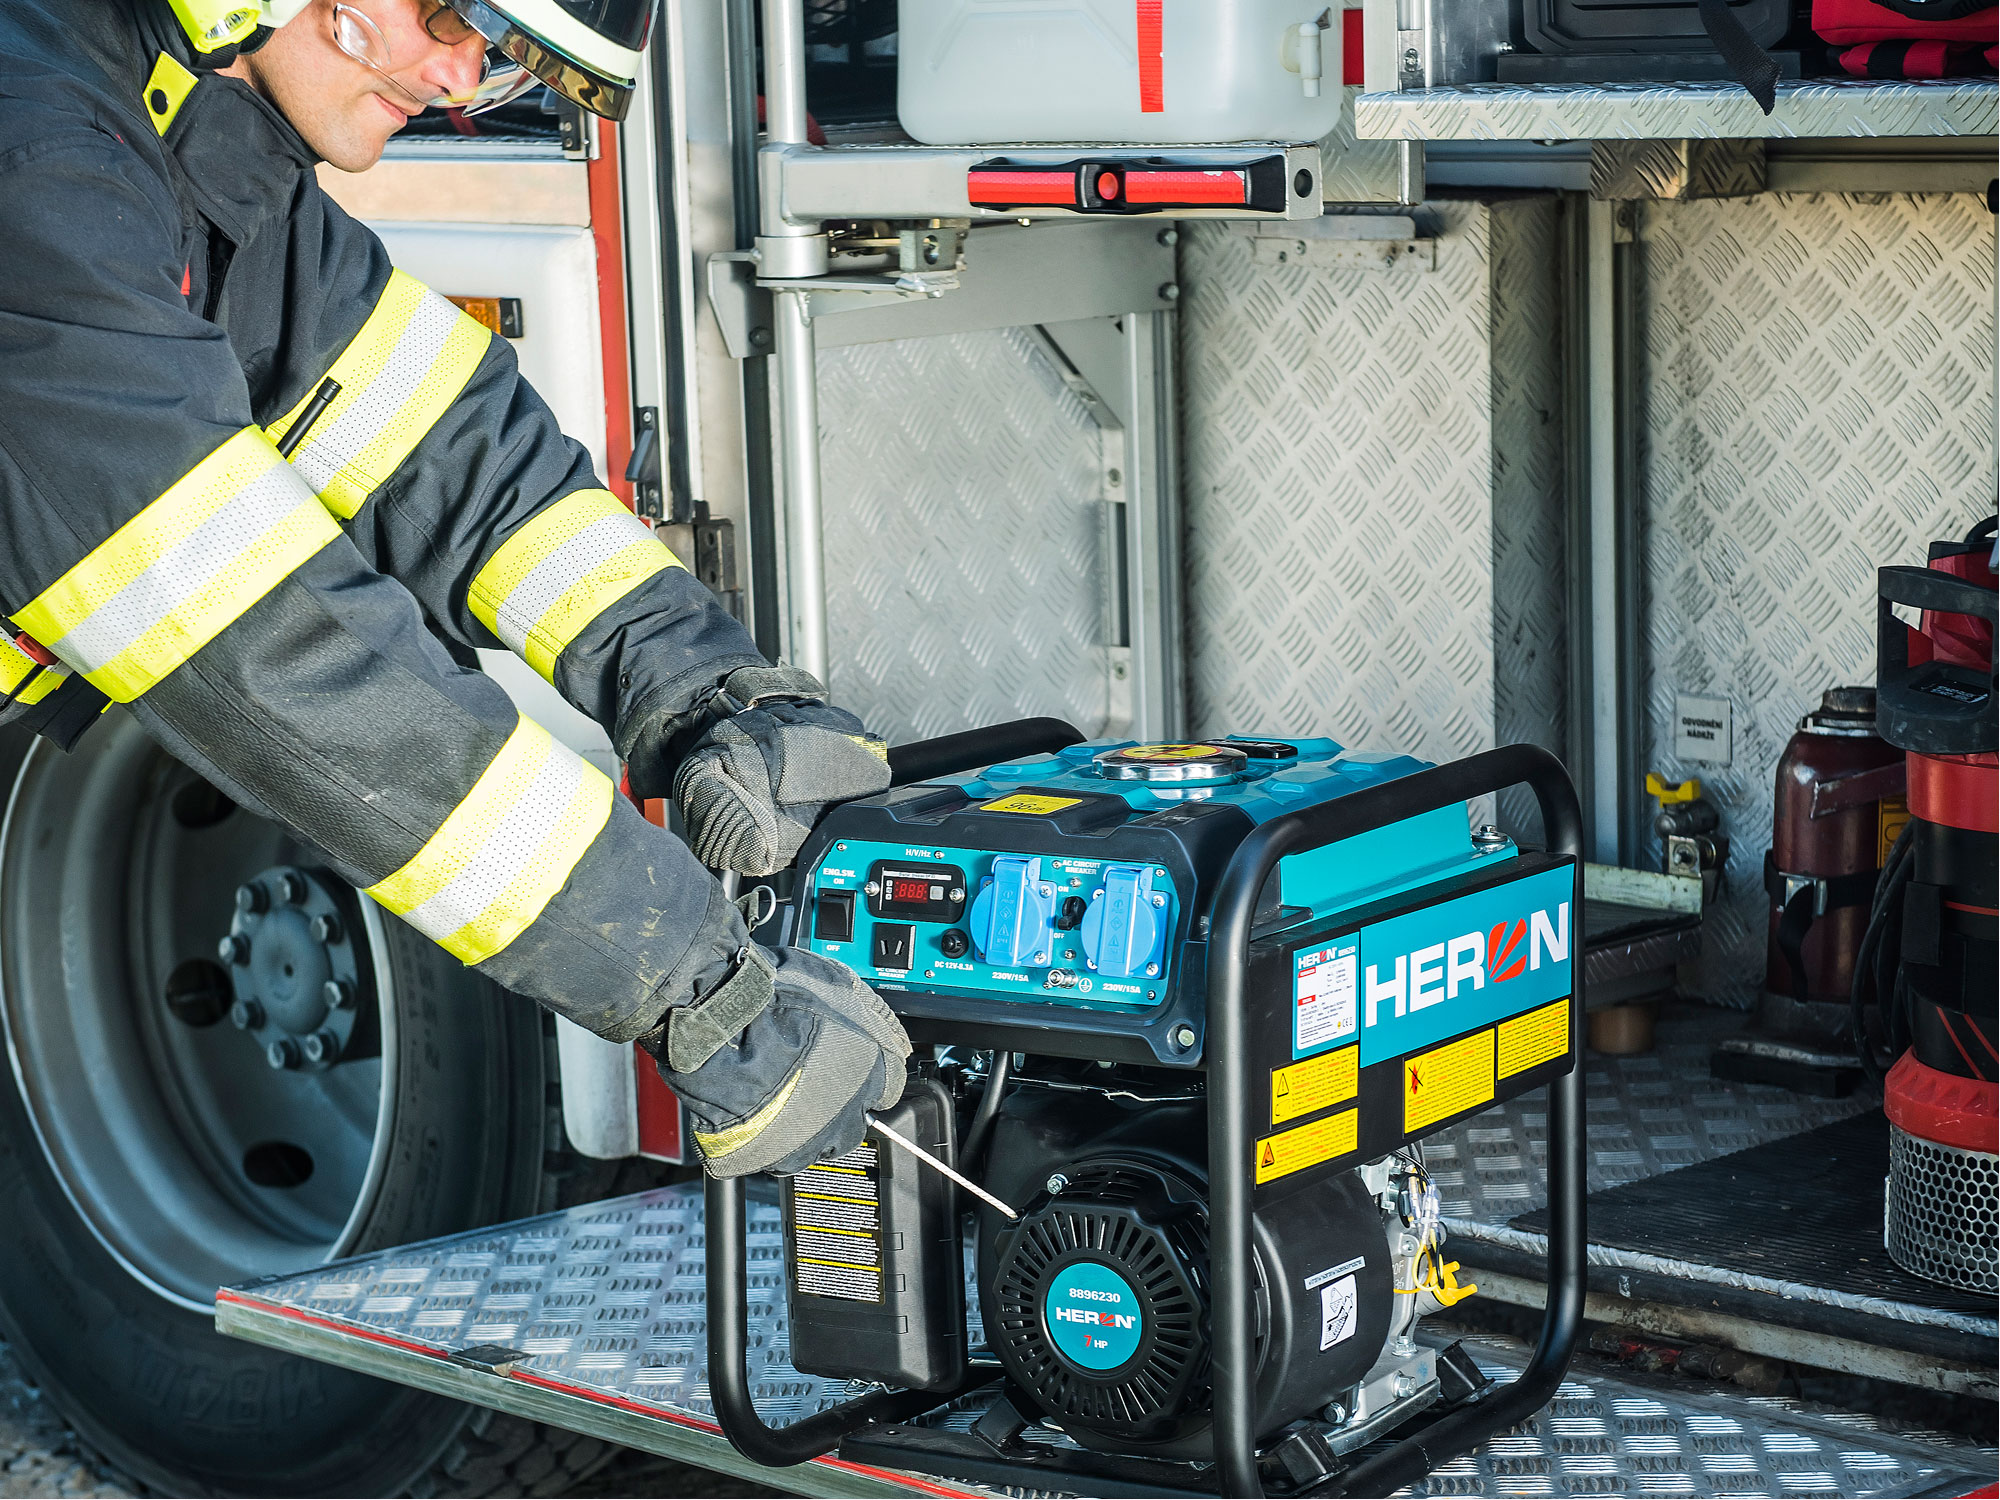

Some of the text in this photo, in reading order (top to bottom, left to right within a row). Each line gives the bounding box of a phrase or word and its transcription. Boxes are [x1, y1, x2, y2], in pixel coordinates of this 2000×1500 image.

[905, 848, 931, 858] H/V/Hz
[1065, 867, 1097, 875] BREAKER
[826, 944, 840, 952] OFF
[934, 960, 943, 968] DC
[1298, 947, 1337, 969] HERON
[1365, 901, 1569, 1028] HERON
[1102, 983, 1141, 993] 230V/15A
[1069, 1287, 1121, 1303] 8896230
[1055, 1307, 1135, 1329] HERON
[1083, 1335, 1108, 1349] 7 HP
